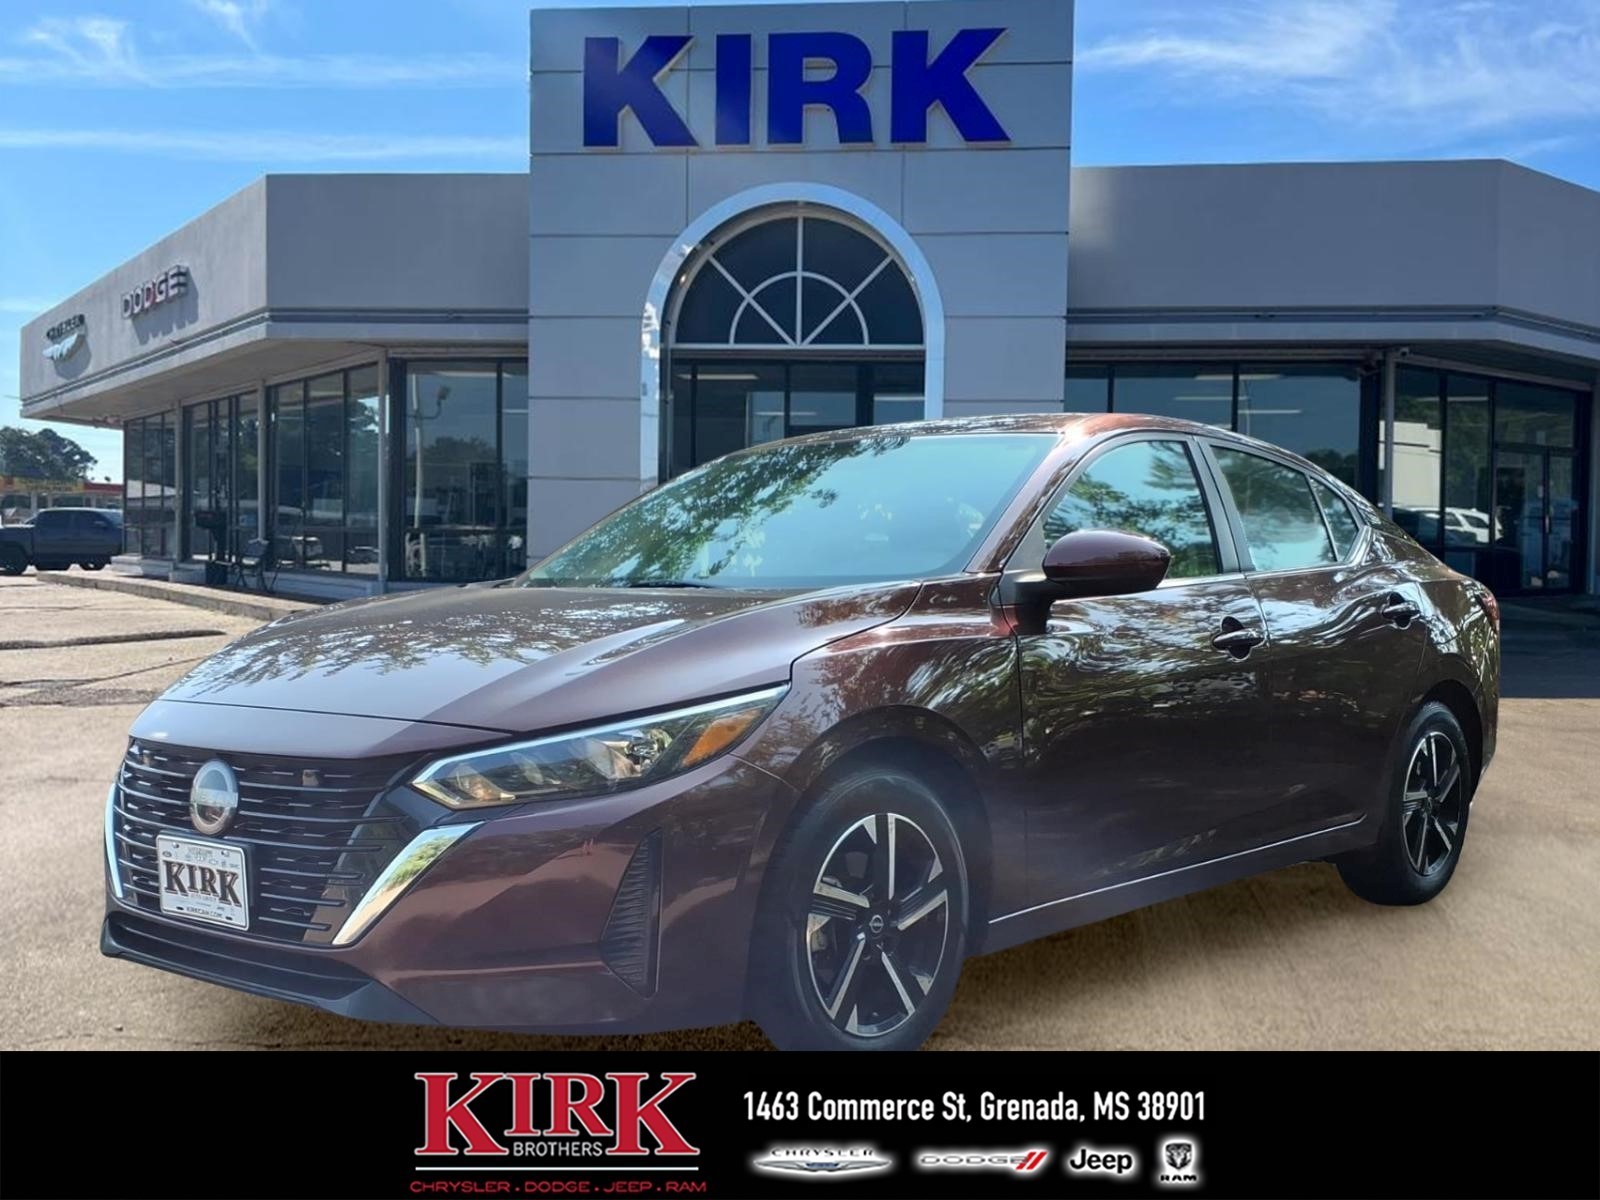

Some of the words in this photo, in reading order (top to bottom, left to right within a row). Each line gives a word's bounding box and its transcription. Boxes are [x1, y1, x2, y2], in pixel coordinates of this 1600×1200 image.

[583, 28, 1011, 147] KIRK
[121, 265, 189, 319] DODGE
[163, 860, 242, 908] KIRK
